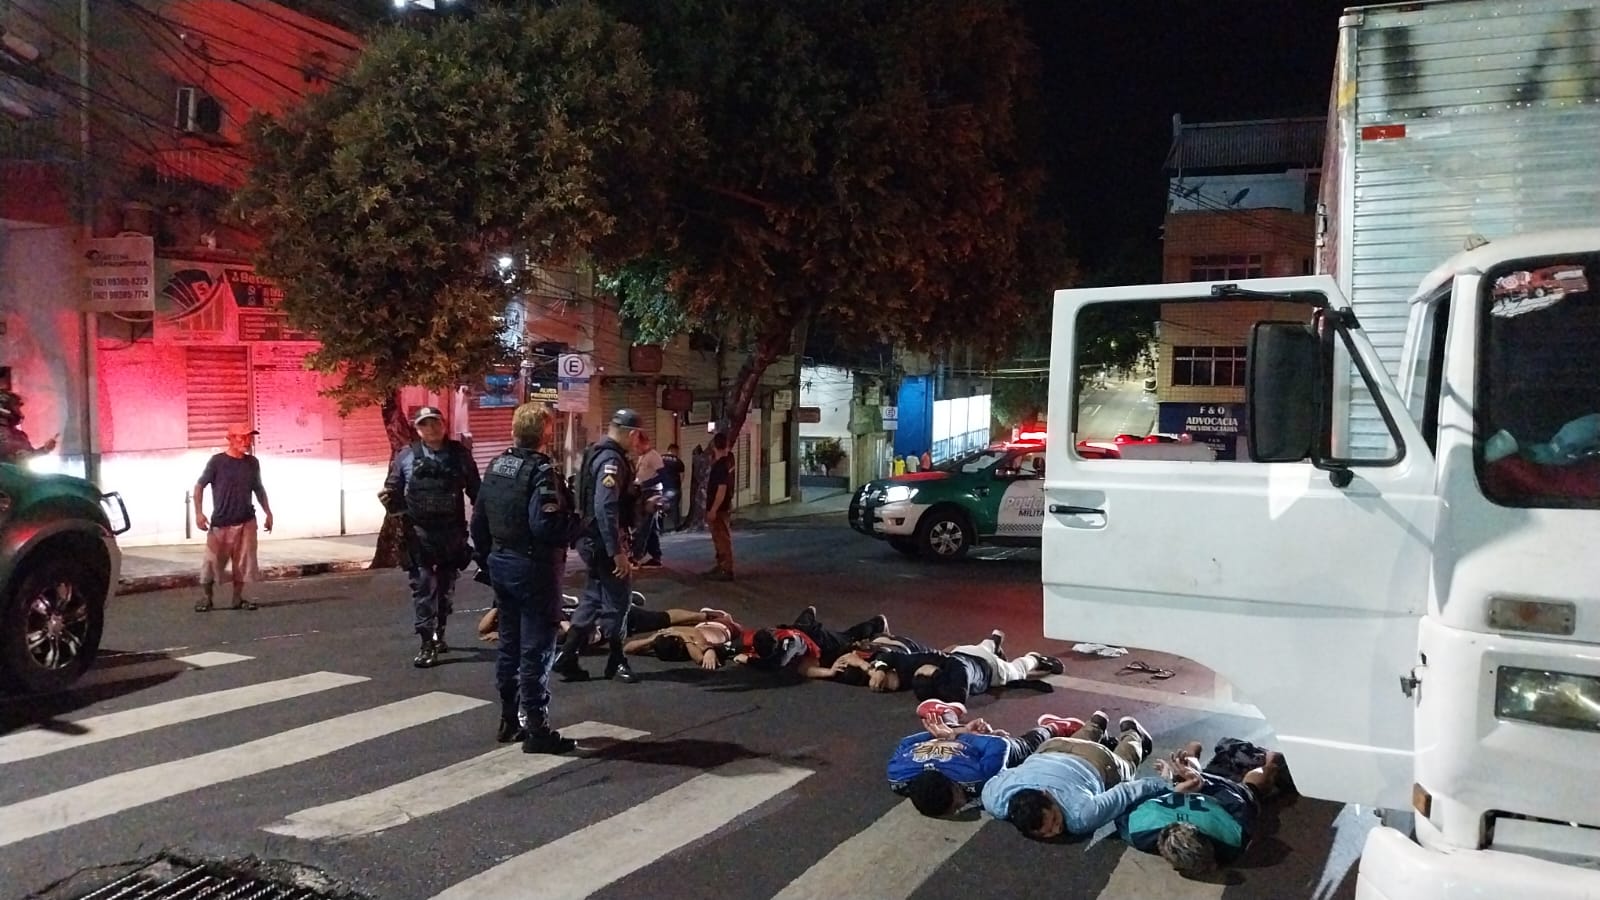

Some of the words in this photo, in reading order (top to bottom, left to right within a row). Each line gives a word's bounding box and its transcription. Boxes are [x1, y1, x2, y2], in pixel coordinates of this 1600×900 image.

[569, 361, 579, 372] E
[1199, 406, 1206, 414] F
[1208, 406, 1215, 414] &
[1217, 406, 1225, 414] O
[1186, 416, 1238, 426] ADVOCACIA
